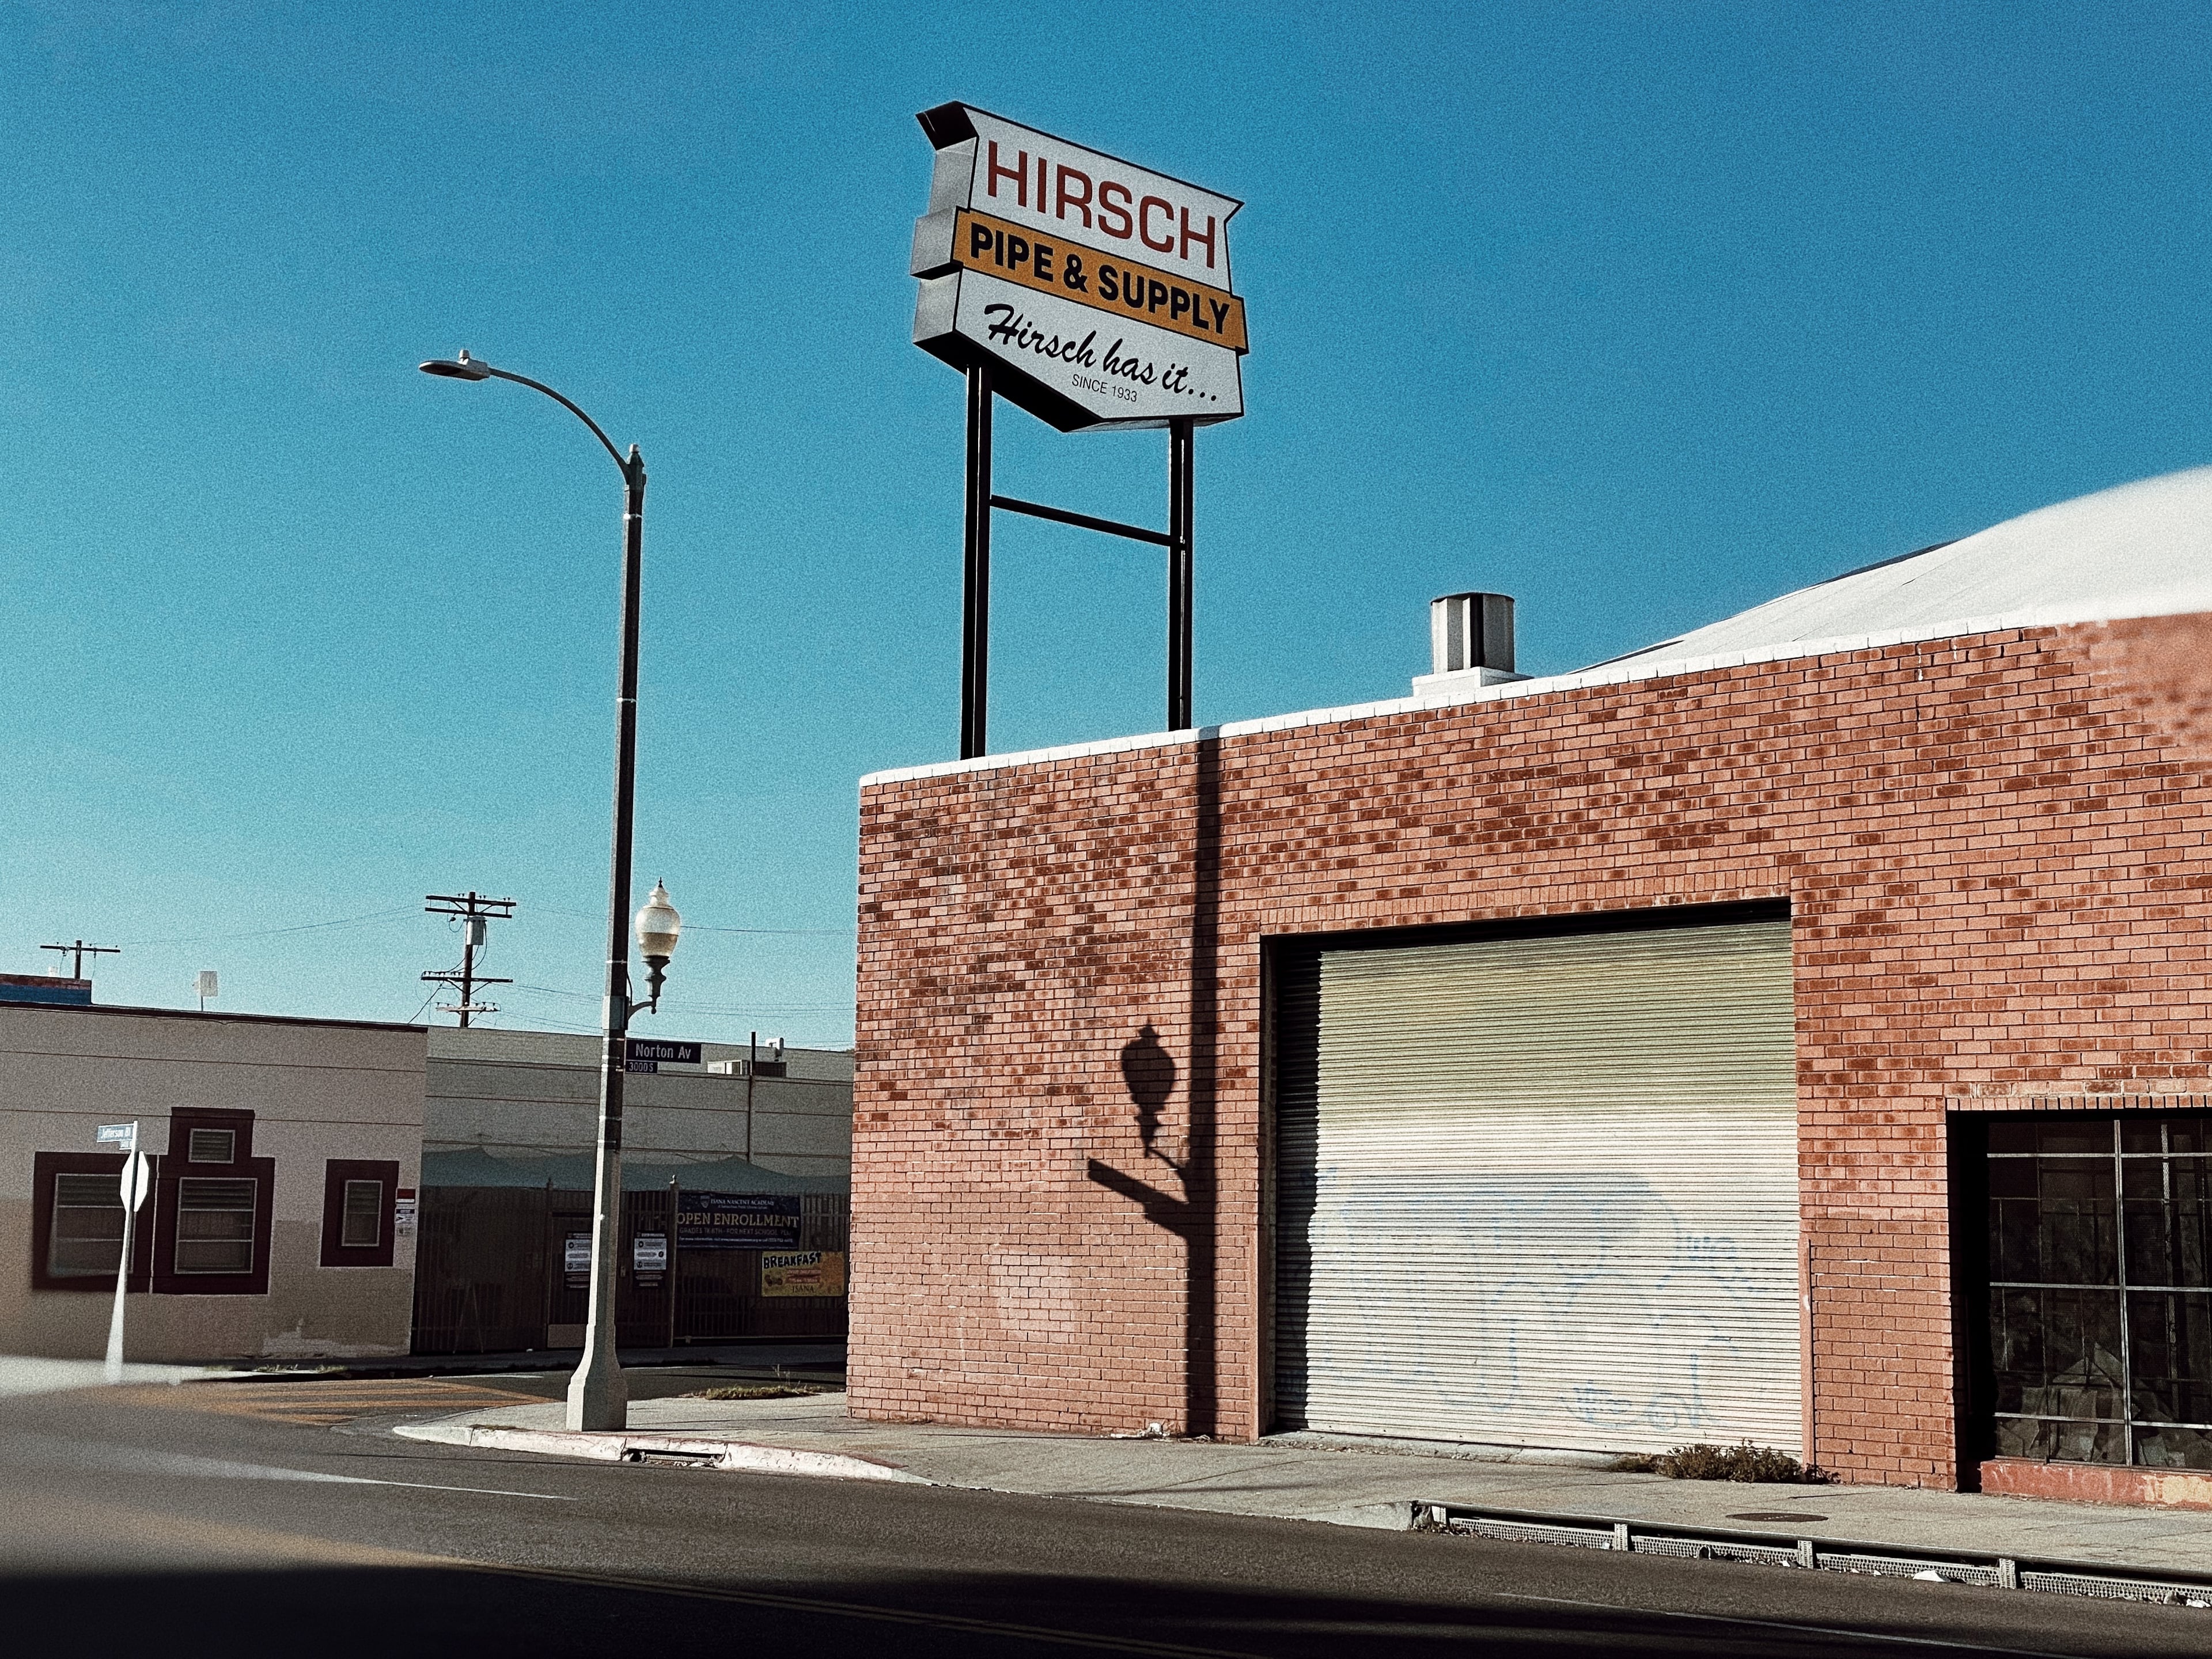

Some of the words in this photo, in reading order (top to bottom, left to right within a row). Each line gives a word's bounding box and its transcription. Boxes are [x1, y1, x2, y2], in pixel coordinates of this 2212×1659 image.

[987, 139, 1215, 269] HIRSCH
[971, 222, 1054, 282] PIPE
[1063, 253, 1089, 293] &
[1098, 264, 1230, 335] SUPPLY
[984, 304, 1097, 368] Hirsch
[1103, 338, 1157, 385] has
[1162, 363, 1217, 401] it...
[1071, 374, 1108, 394] SINCE
[1112, 385, 1138, 402] 1933
[635, 1043, 673, 1058] Norton
[678, 1046, 691, 1059] Av
[628, 1062, 648, 1071] 3000
[677, 1212, 711, 1225] OPEN
[714, 1213, 799, 1228] ENROLLMENT
[763, 1252, 822, 1269] BREAKFAST
[792, 1285, 814, 1293] ISANA
